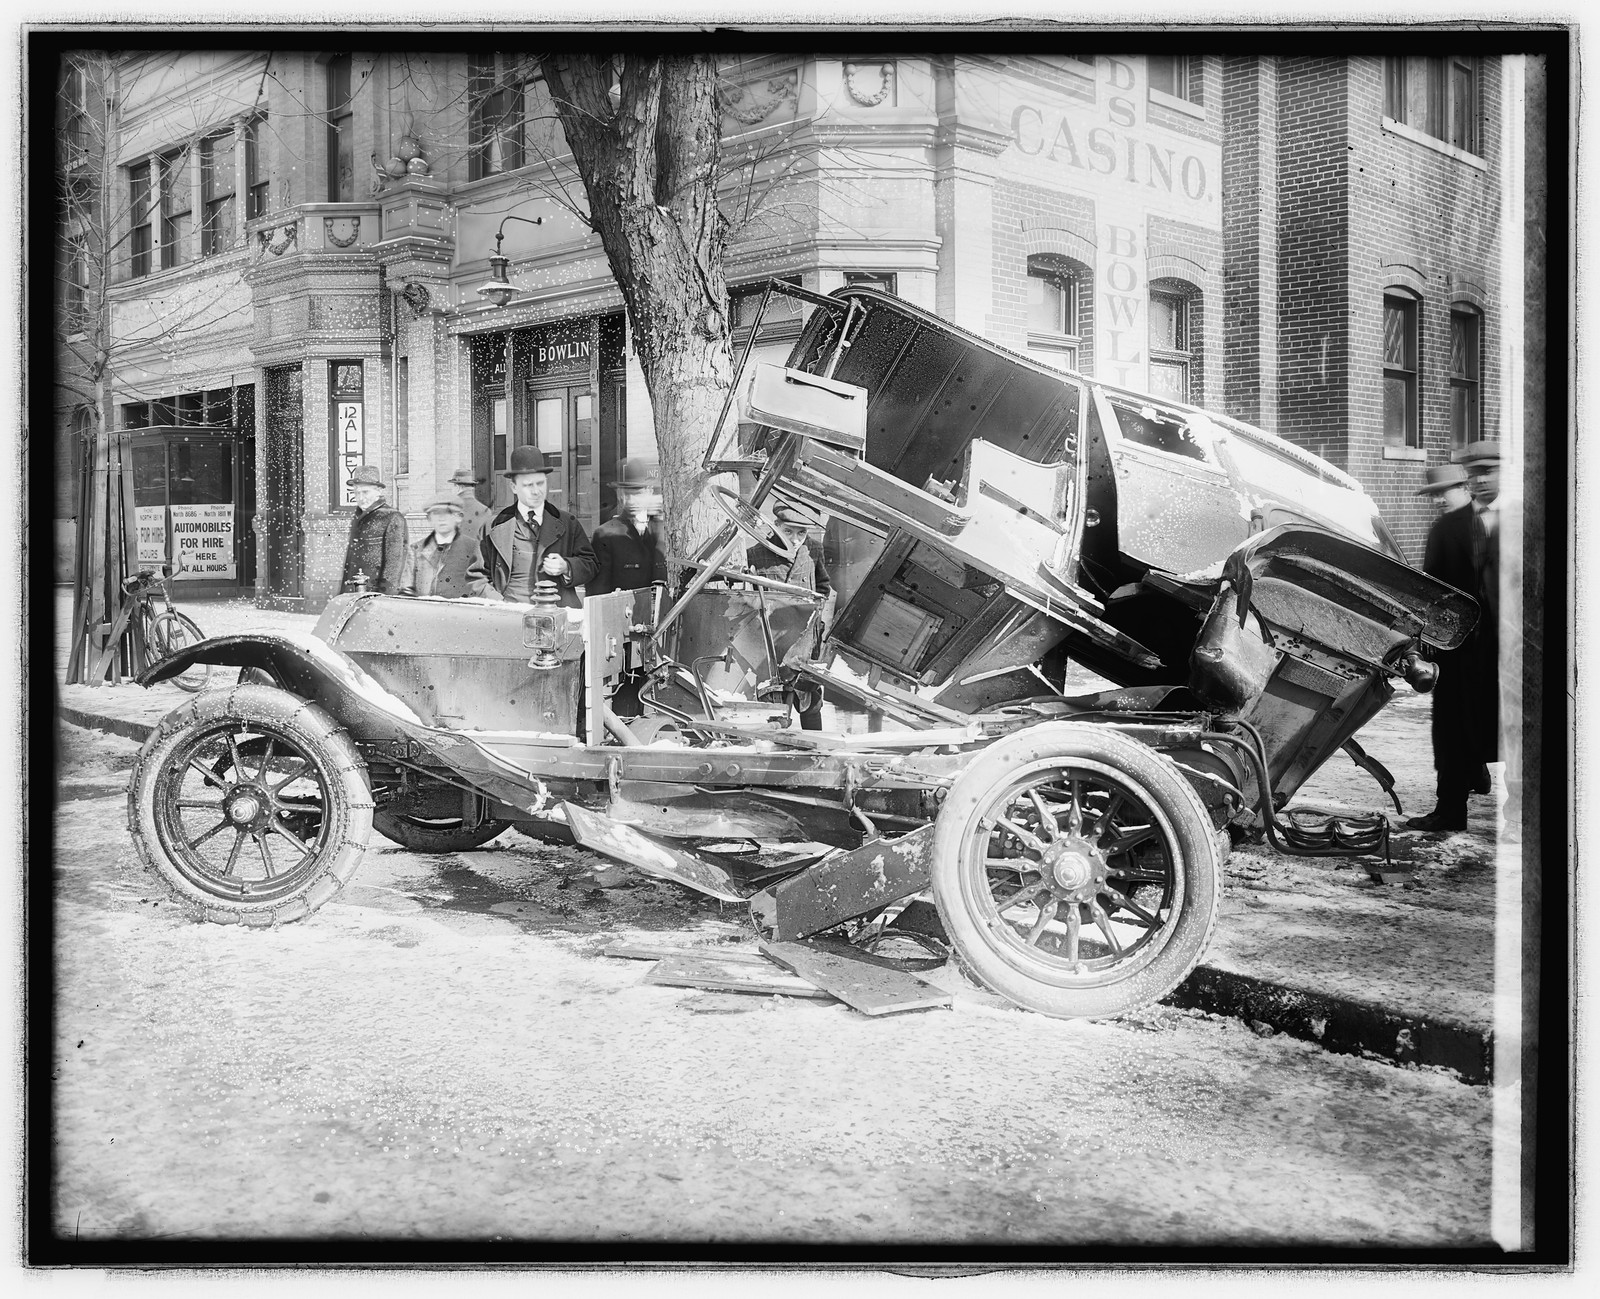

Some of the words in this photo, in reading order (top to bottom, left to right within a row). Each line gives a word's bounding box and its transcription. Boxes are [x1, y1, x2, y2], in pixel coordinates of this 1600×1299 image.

[1010, 105, 1213, 203] CASINO.
[344, 406, 357, 419] 12
[345, 419, 358, 492] ALLEYS
[346, 492, 357, 503] 12
[174, 522, 232, 533] AUTOMOBILES
[140, 526, 151, 543] FOR
[180, 538, 199, 549] FOR
[202, 537, 224, 548] HIRE
[140, 549, 158, 559] HOURS
[195, 552, 217, 560] HERE
[181, 564, 189, 572] AT
[192, 564, 204, 572] ALL
[206, 563, 228, 572] HOURS
